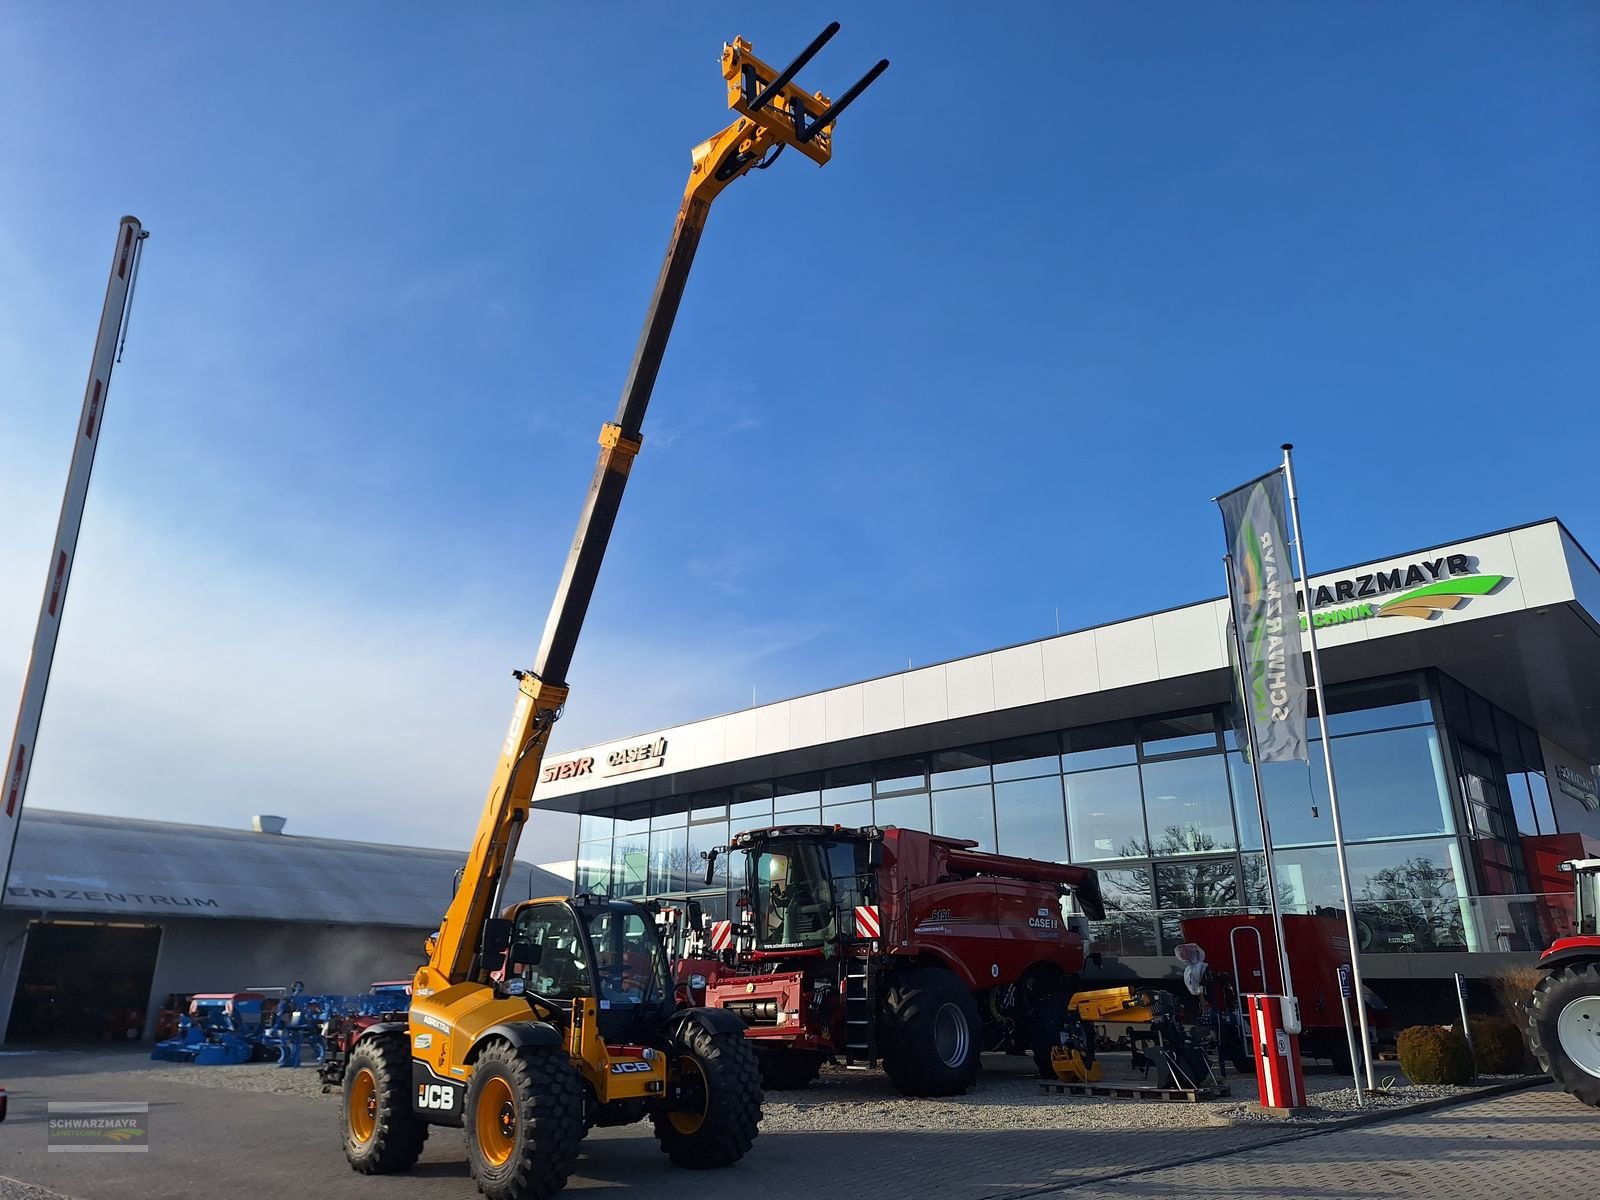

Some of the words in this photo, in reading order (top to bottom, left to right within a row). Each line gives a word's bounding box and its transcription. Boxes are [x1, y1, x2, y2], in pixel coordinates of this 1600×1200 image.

[541, 756, 593, 783] STEYR
[611, 1061, 652, 1074] JCB
[418, 1084, 454, 1110] JCB
